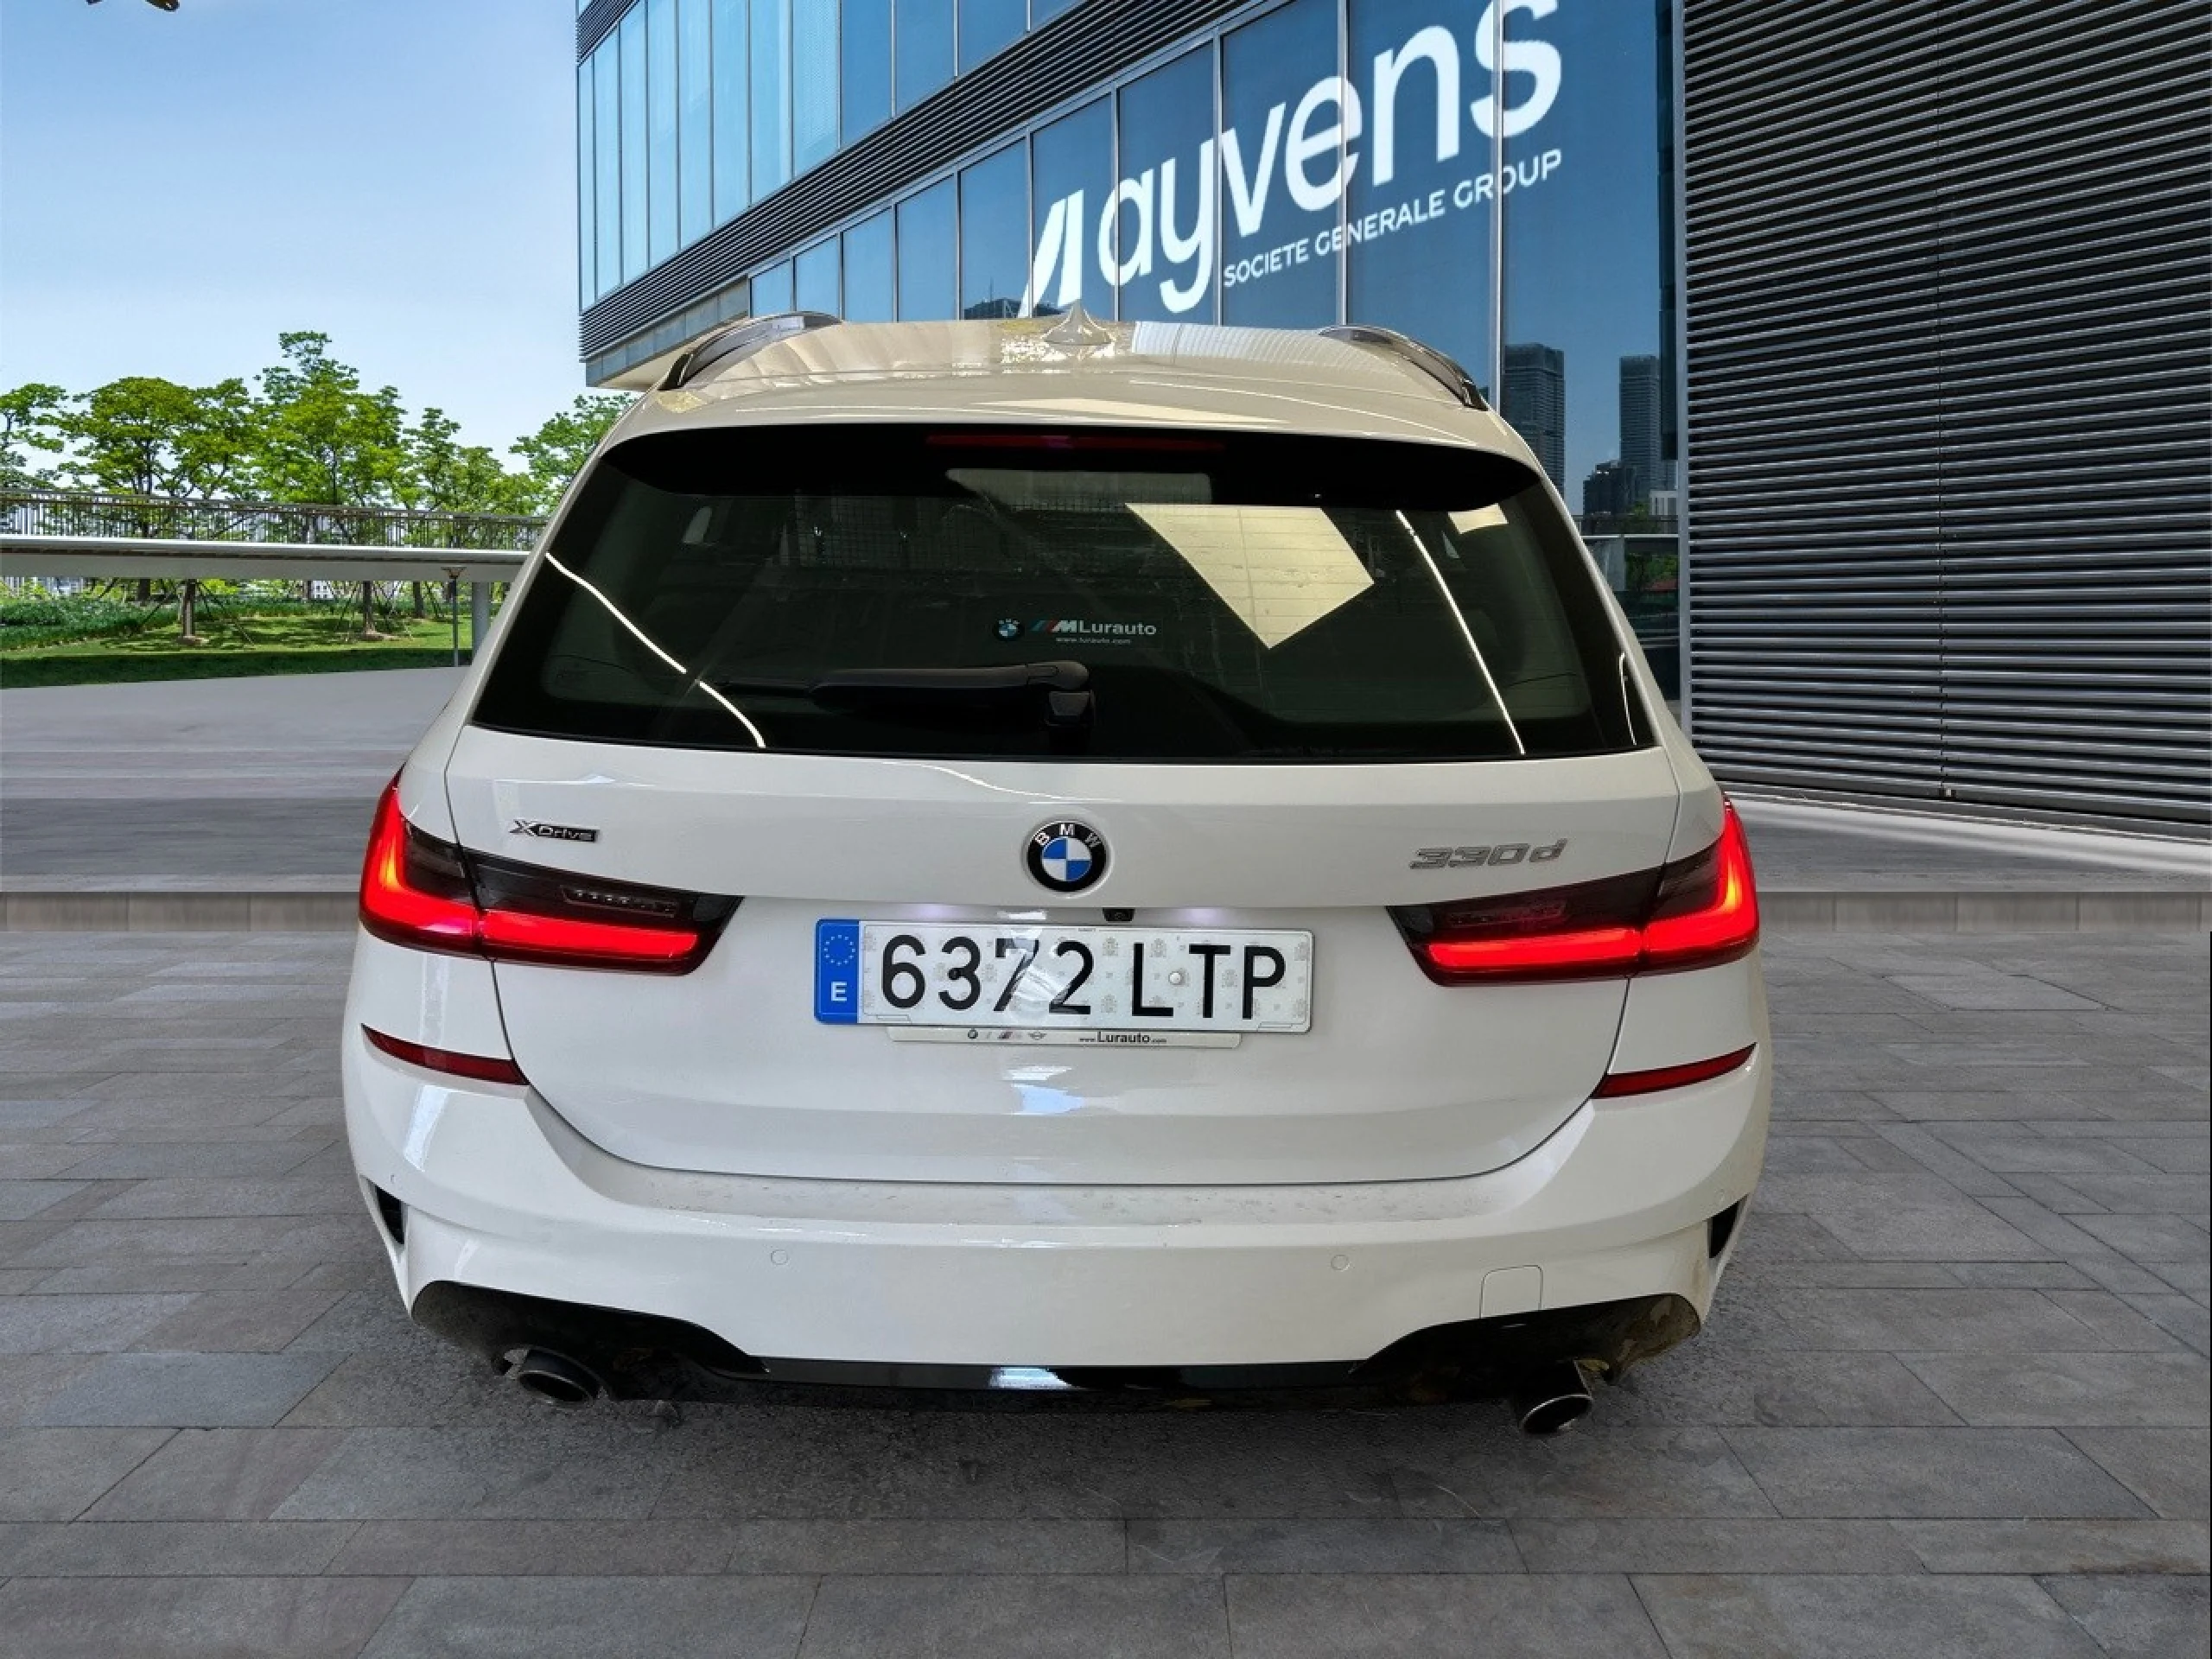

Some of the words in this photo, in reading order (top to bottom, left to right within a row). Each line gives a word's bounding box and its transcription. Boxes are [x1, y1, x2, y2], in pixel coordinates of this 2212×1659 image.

[1097, 0, 1561, 314] ayvens
[1223, 238, 1309, 287] SOCIETE
[1314, 189, 1446, 253] GENERALE
[1453, 149, 1561, 210] GROUP
[1079, 620, 1157, 636] Lurauto
[1034, 823, 1103, 848] BMW
[1408, 837, 1568, 870] 330d
[830, 982, 848, 1001] E
[880, 934, 1095, 1014] 6372
[1132, 943, 1287, 1020] LTP
